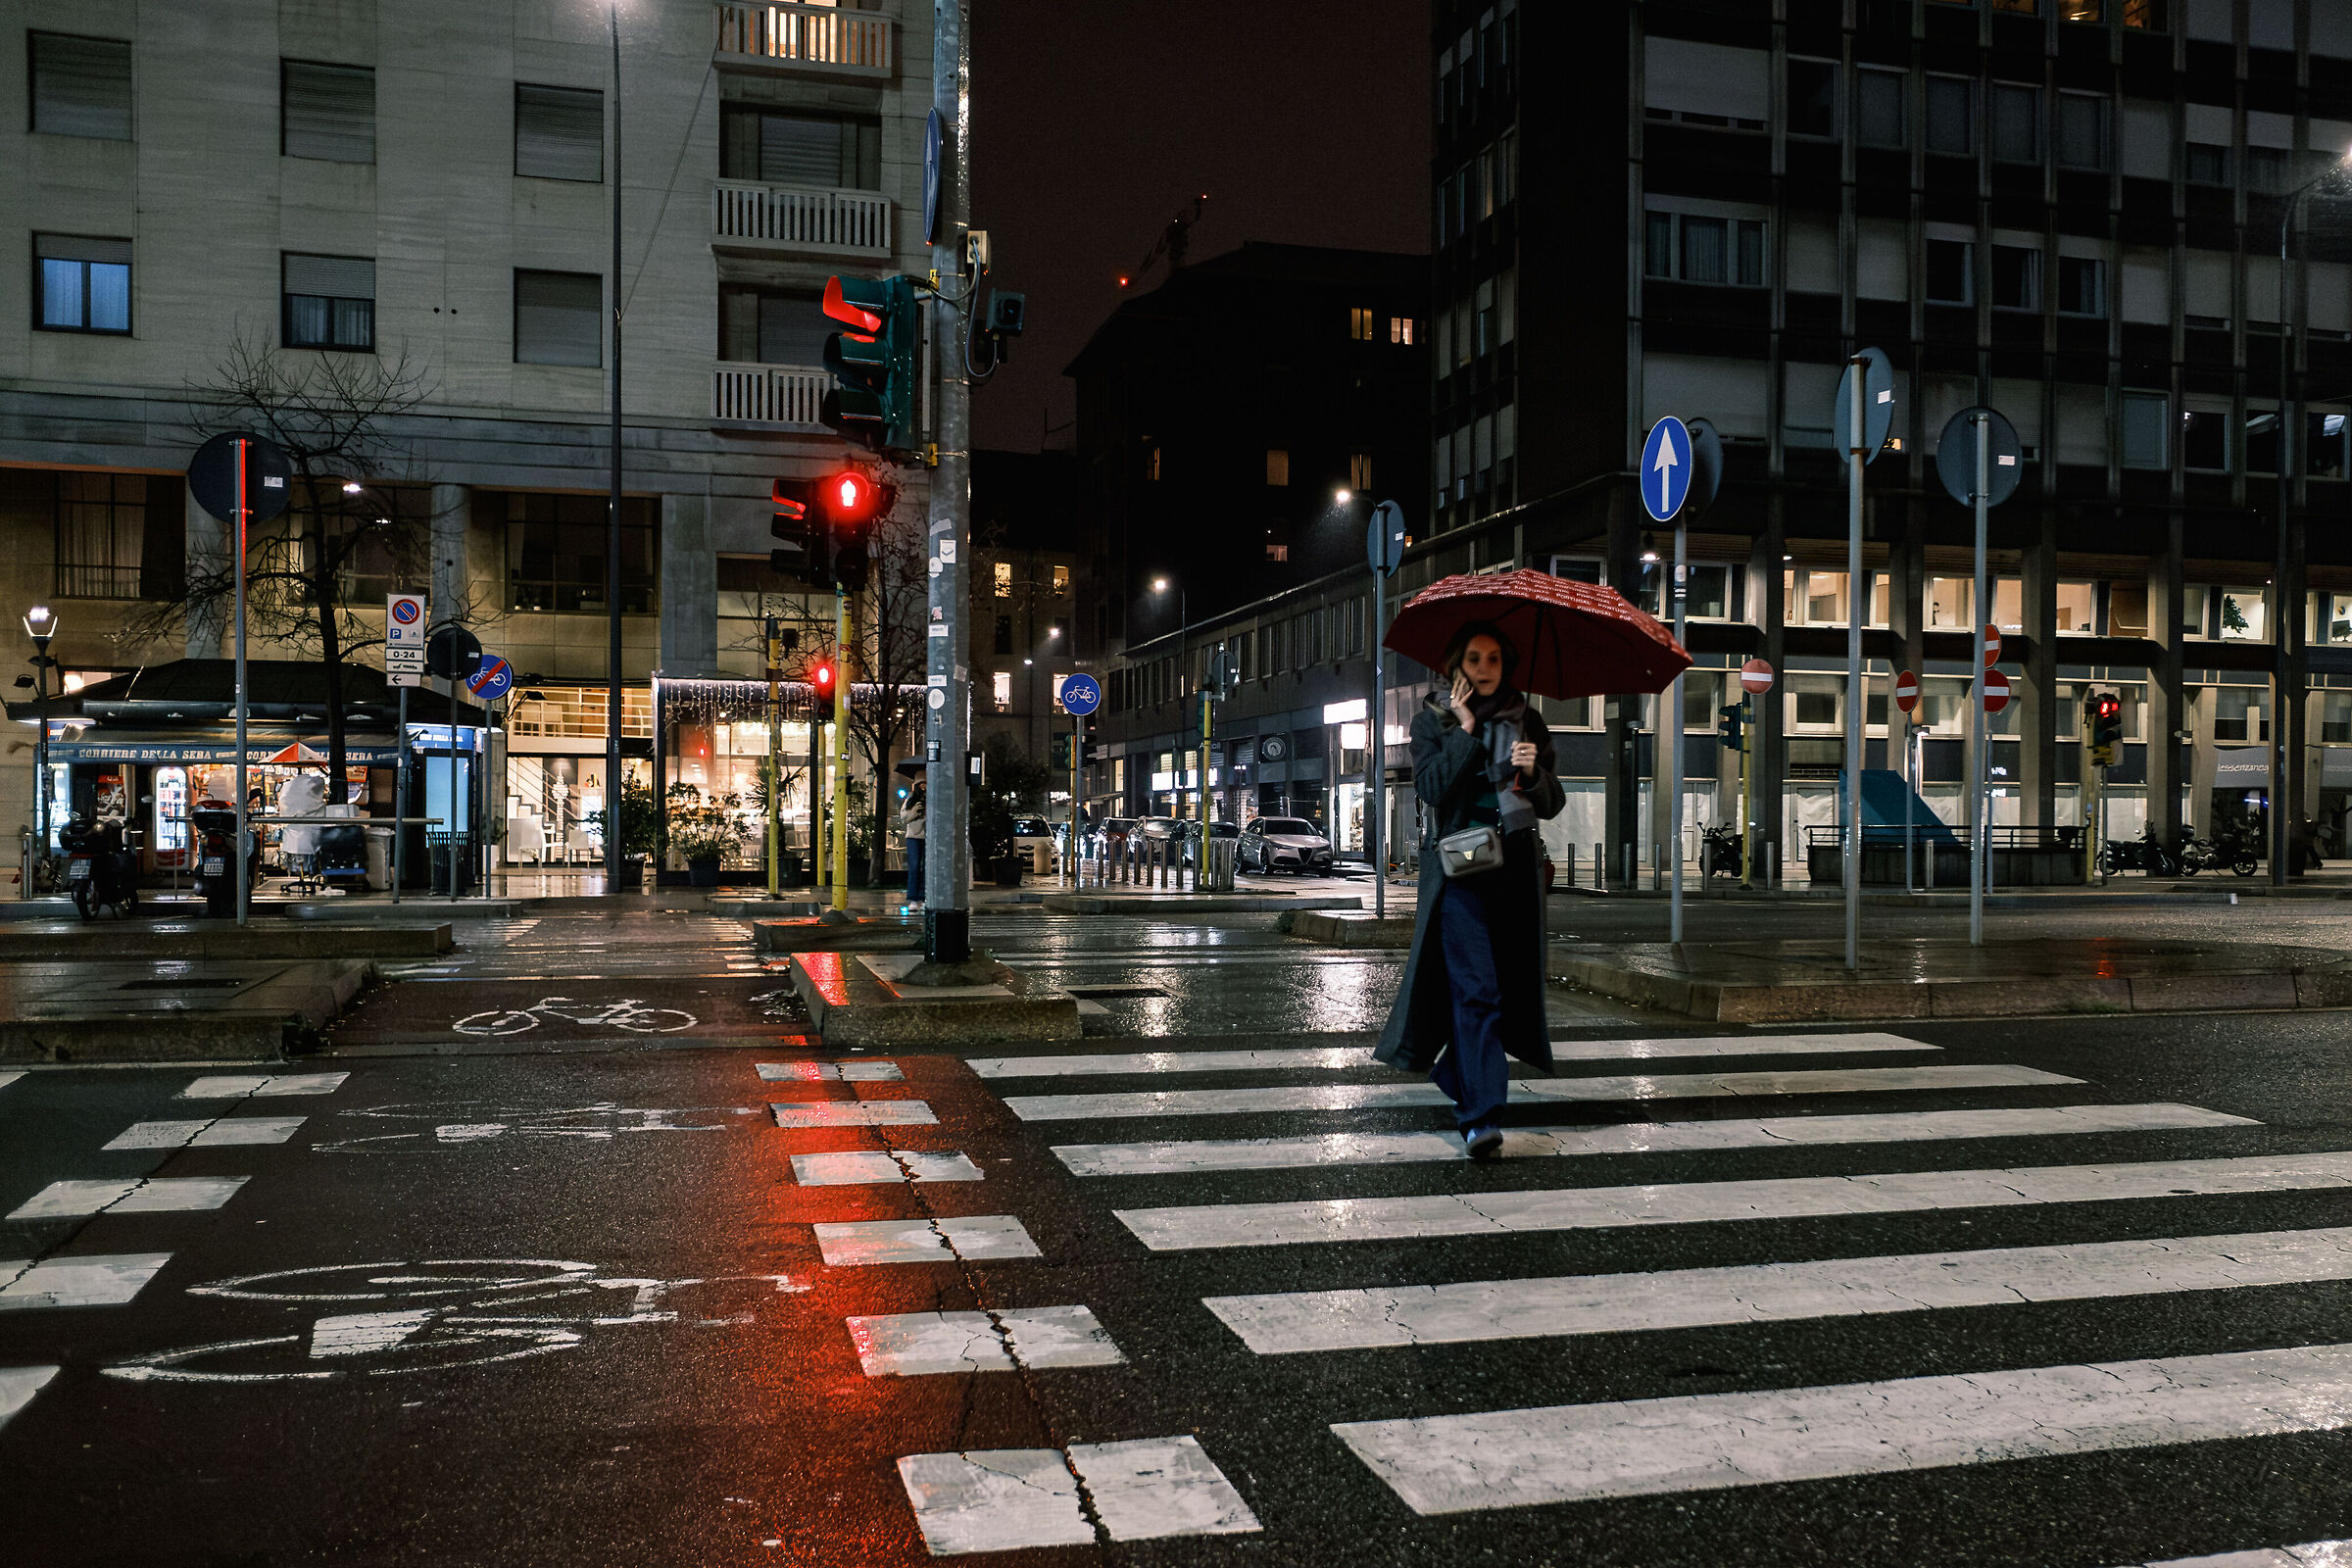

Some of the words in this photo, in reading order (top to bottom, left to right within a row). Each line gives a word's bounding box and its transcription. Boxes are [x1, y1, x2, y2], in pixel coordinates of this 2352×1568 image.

[1576, 605, 1613, 617] PORTUGAL
[392, 629, 400, 638] P
[78, 749, 136, 760] CORRIERE
[141, 750, 177, 760] DELLA
[181, 750, 212, 760] SERA
[345, 751, 373, 761] SERA
